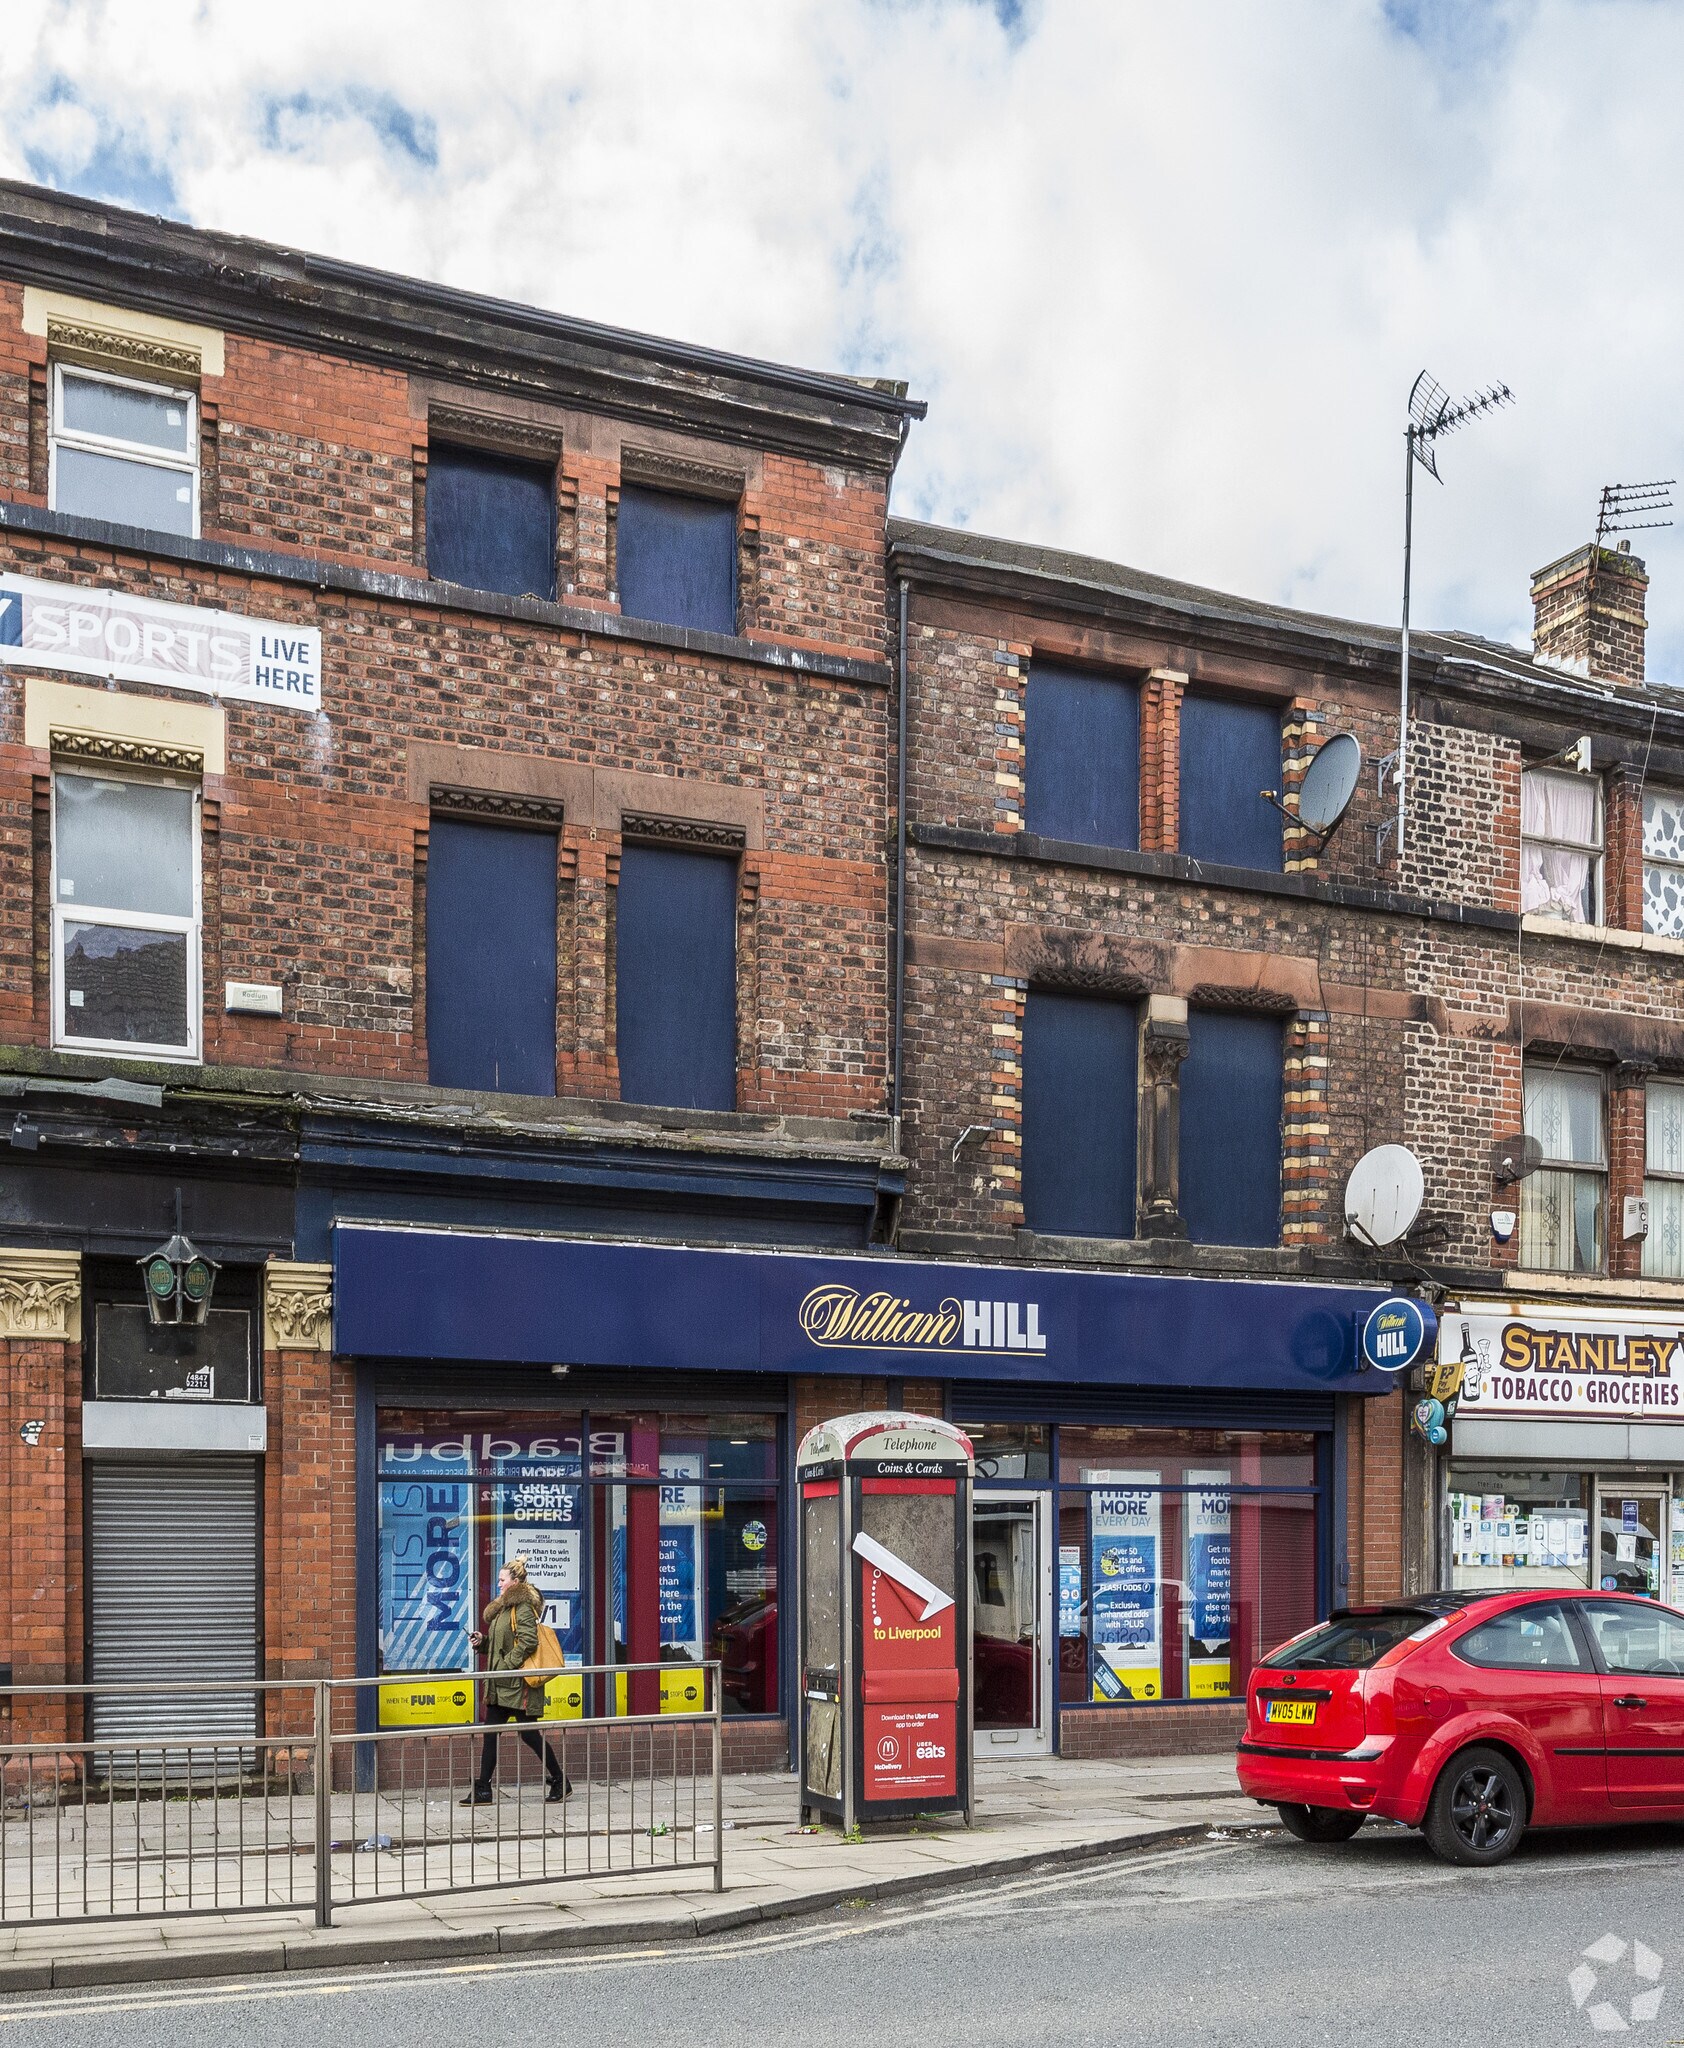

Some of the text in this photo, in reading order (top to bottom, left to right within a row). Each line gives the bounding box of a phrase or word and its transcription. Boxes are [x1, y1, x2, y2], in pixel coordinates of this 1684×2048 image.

[31, 605, 242, 673] SPORTS
[261, 636, 309, 664] LIVE
[256, 665, 314, 695] HERE
[799, 1284, 1047, 1349] William HILL
[1376, 1331, 1407, 1358] HILL
[1491, 1376, 1679, 1406] TOBACCO GROCERIES
[883, 1437, 937, 1453] Telephone
[877, 1461, 943, 1474] Coins & Cards
[661, 1486, 686, 1503] RE
[391, 1485, 424, 1517] IS
[513, 1494, 574, 1508] SPORTS
[1101, 1500, 1148, 1515] MORE
[513, 1508, 573, 1522] OFFERS
[1196, 1515, 1229, 1526] EVERY
[1096, 1515, 1152, 1527] EVERY DAY
[1128, 1547, 1138, 1555] 50
[1207, 1545, 1221, 1553] Get
[426, 1484, 460, 1632] MORE
[1129, 1556, 1143, 1564] and
[1210, 1556, 1231, 1565] footb
[542, 1570, 567, 1578] Vargas)
[1125, 1565, 1146, 1573] offers
[391, 1534, 424, 1633] THIS
[659, 1577, 679, 1586] than
[1207, 1579, 1224, 1588] here
[1206, 1592, 1231, 1601] anywh
[666, 1602, 682, 1611] the
[1110, 1601, 1140, 1609] Exclusive
[1205, 1603, 1230, 1612] else on
[660, 1614, 682, 1624] treet
[1100, 1610, 1149, 1618] enhanced odds
[1205, 1614, 1221, 1625] high
[1105, 1620, 1121, 1628] with
[873, 1625, 942, 1642] to Liverpool
[684, 1689, 697, 1698] STOP
[400, 1696, 409, 1704] THE
[411, 1694, 436, 1706] FUN
[436, 1696, 452, 1704] STOPS
[453, 1695, 467, 1703] STOP
[568, 1696, 581, 1704] STOP
[881, 1713, 906, 1721] Download
[916, 1744, 946, 1759] eats
